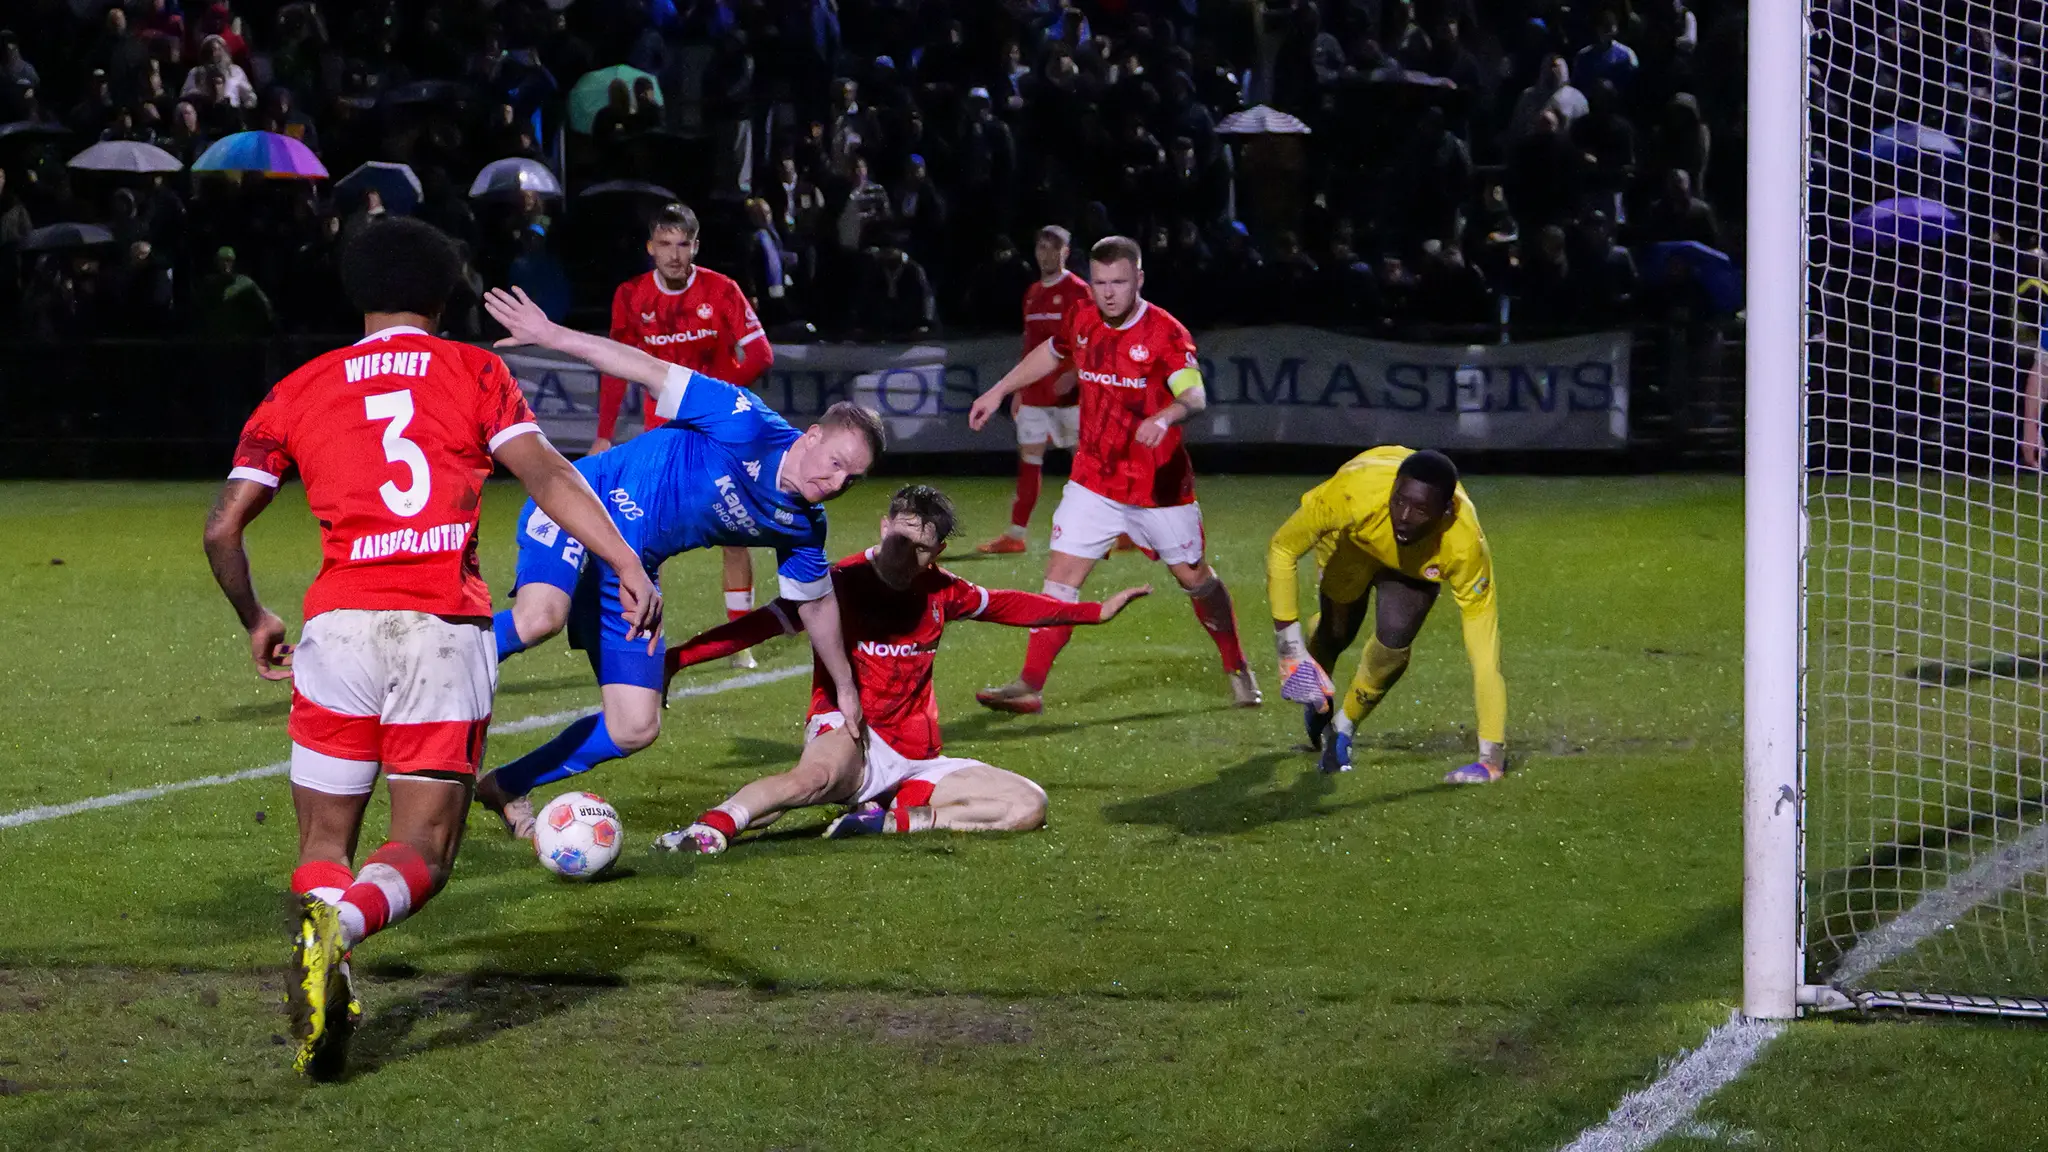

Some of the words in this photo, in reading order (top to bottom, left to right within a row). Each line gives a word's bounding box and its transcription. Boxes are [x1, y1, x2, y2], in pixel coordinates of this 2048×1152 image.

[344, 352, 431, 383] WIESNET
[364, 388, 431, 517] 3
[609, 487, 644, 520] 1903
[712, 502, 738, 532] SHOES
[562, 536, 588, 571] 2
